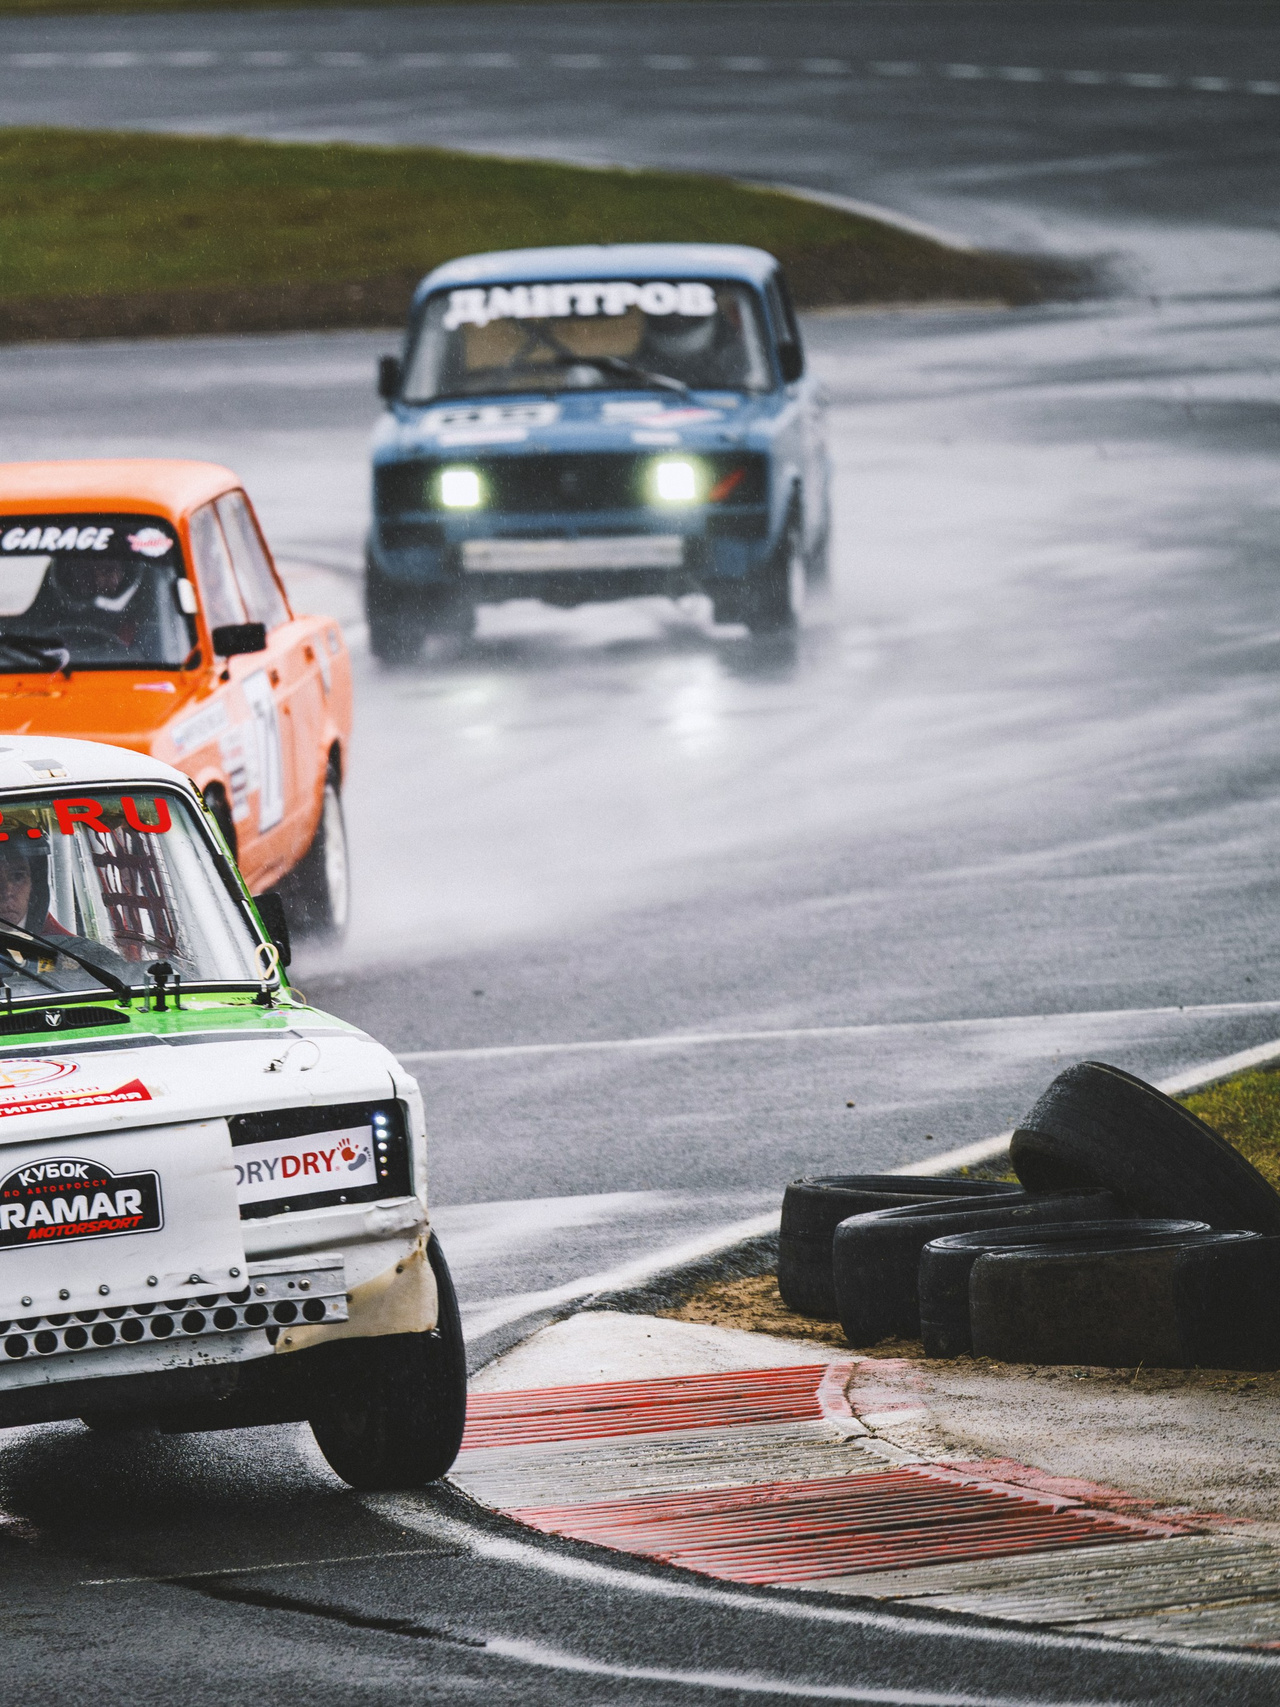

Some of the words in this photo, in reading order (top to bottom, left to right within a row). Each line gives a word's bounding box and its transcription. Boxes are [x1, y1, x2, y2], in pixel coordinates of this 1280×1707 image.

[442, 281, 718, 331] ДМИТРОВ
[1, 526, 114, 551] GARAGE
[18, 1162, 90, 1187] КУБОК
[3, 1190, 20, 1198] ПО
[27, 1179, 107, 1195] АВТОКРОССУ
[27, 1215, 143, 1240] MOTORSPORT
